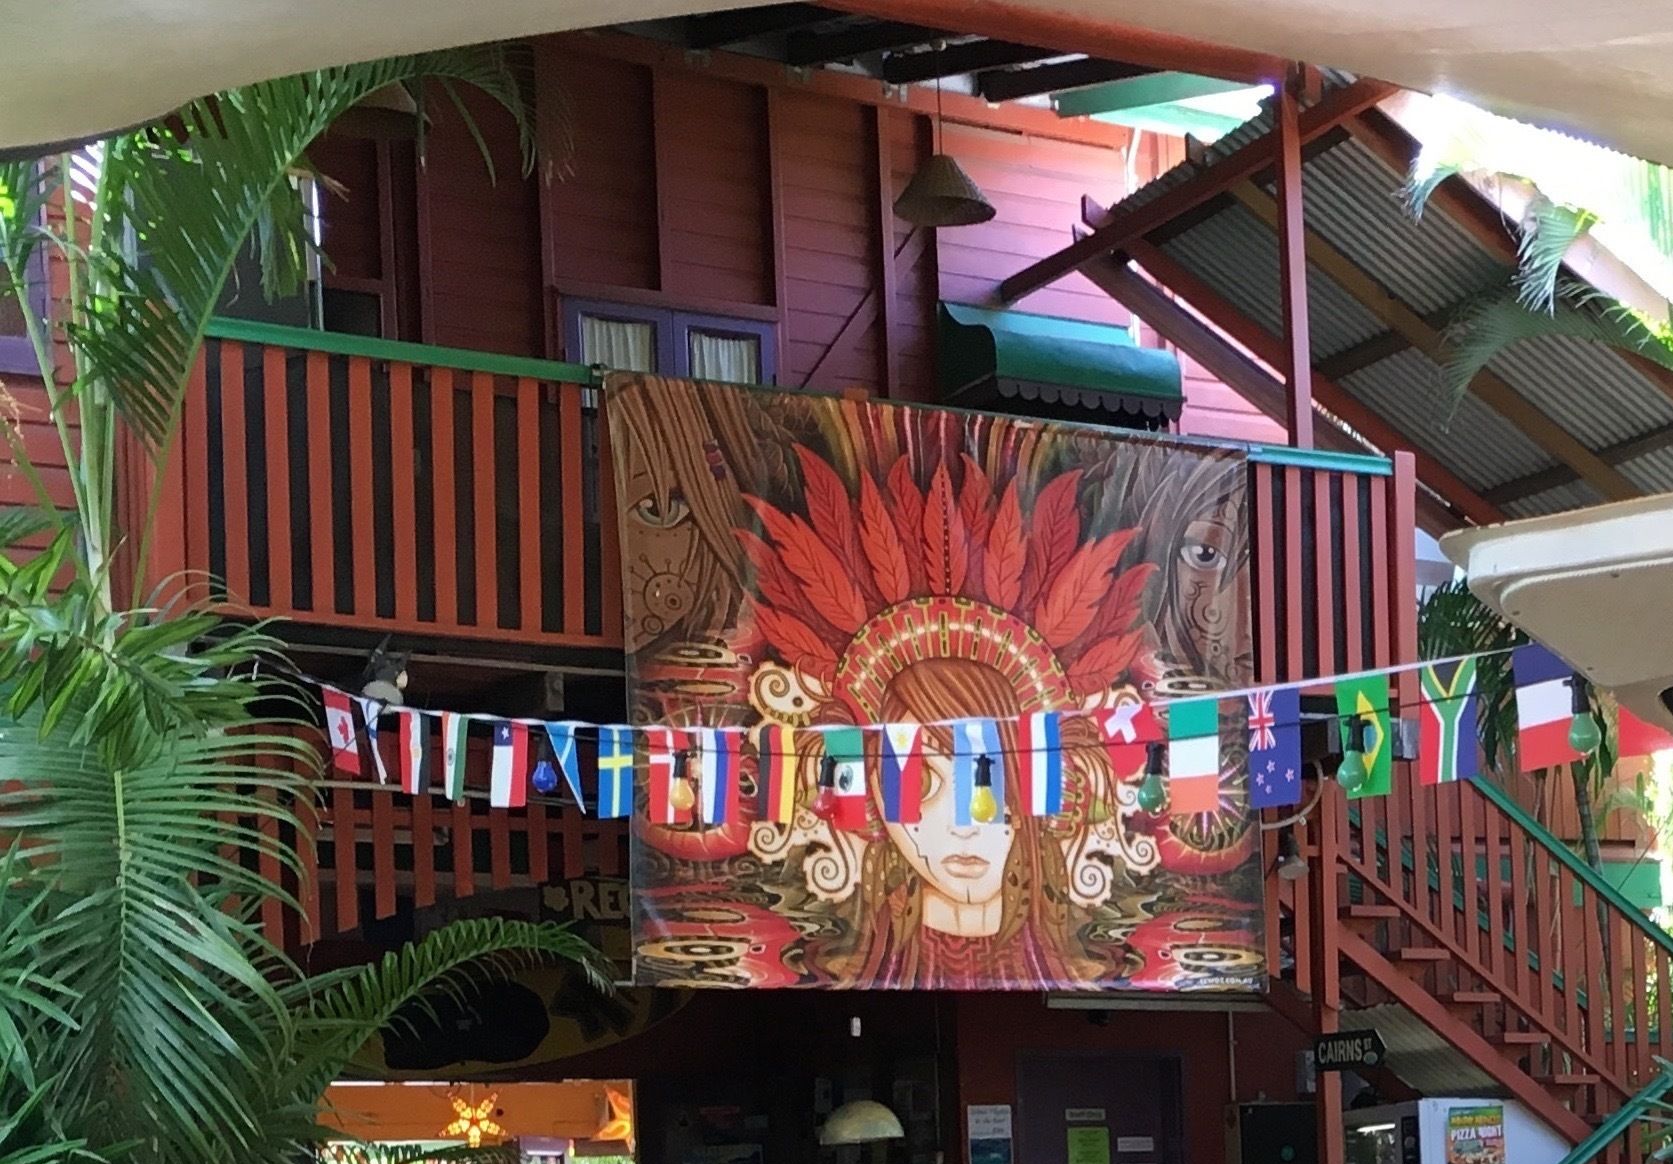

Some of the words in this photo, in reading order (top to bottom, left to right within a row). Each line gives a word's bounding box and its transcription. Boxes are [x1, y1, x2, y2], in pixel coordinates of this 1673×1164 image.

[1318, 1038, 1363, 1064] CAIRNS
[1364, 1038, 1372, 1050] ST
[1451, 1127, 1476, 1141] PIZZA
